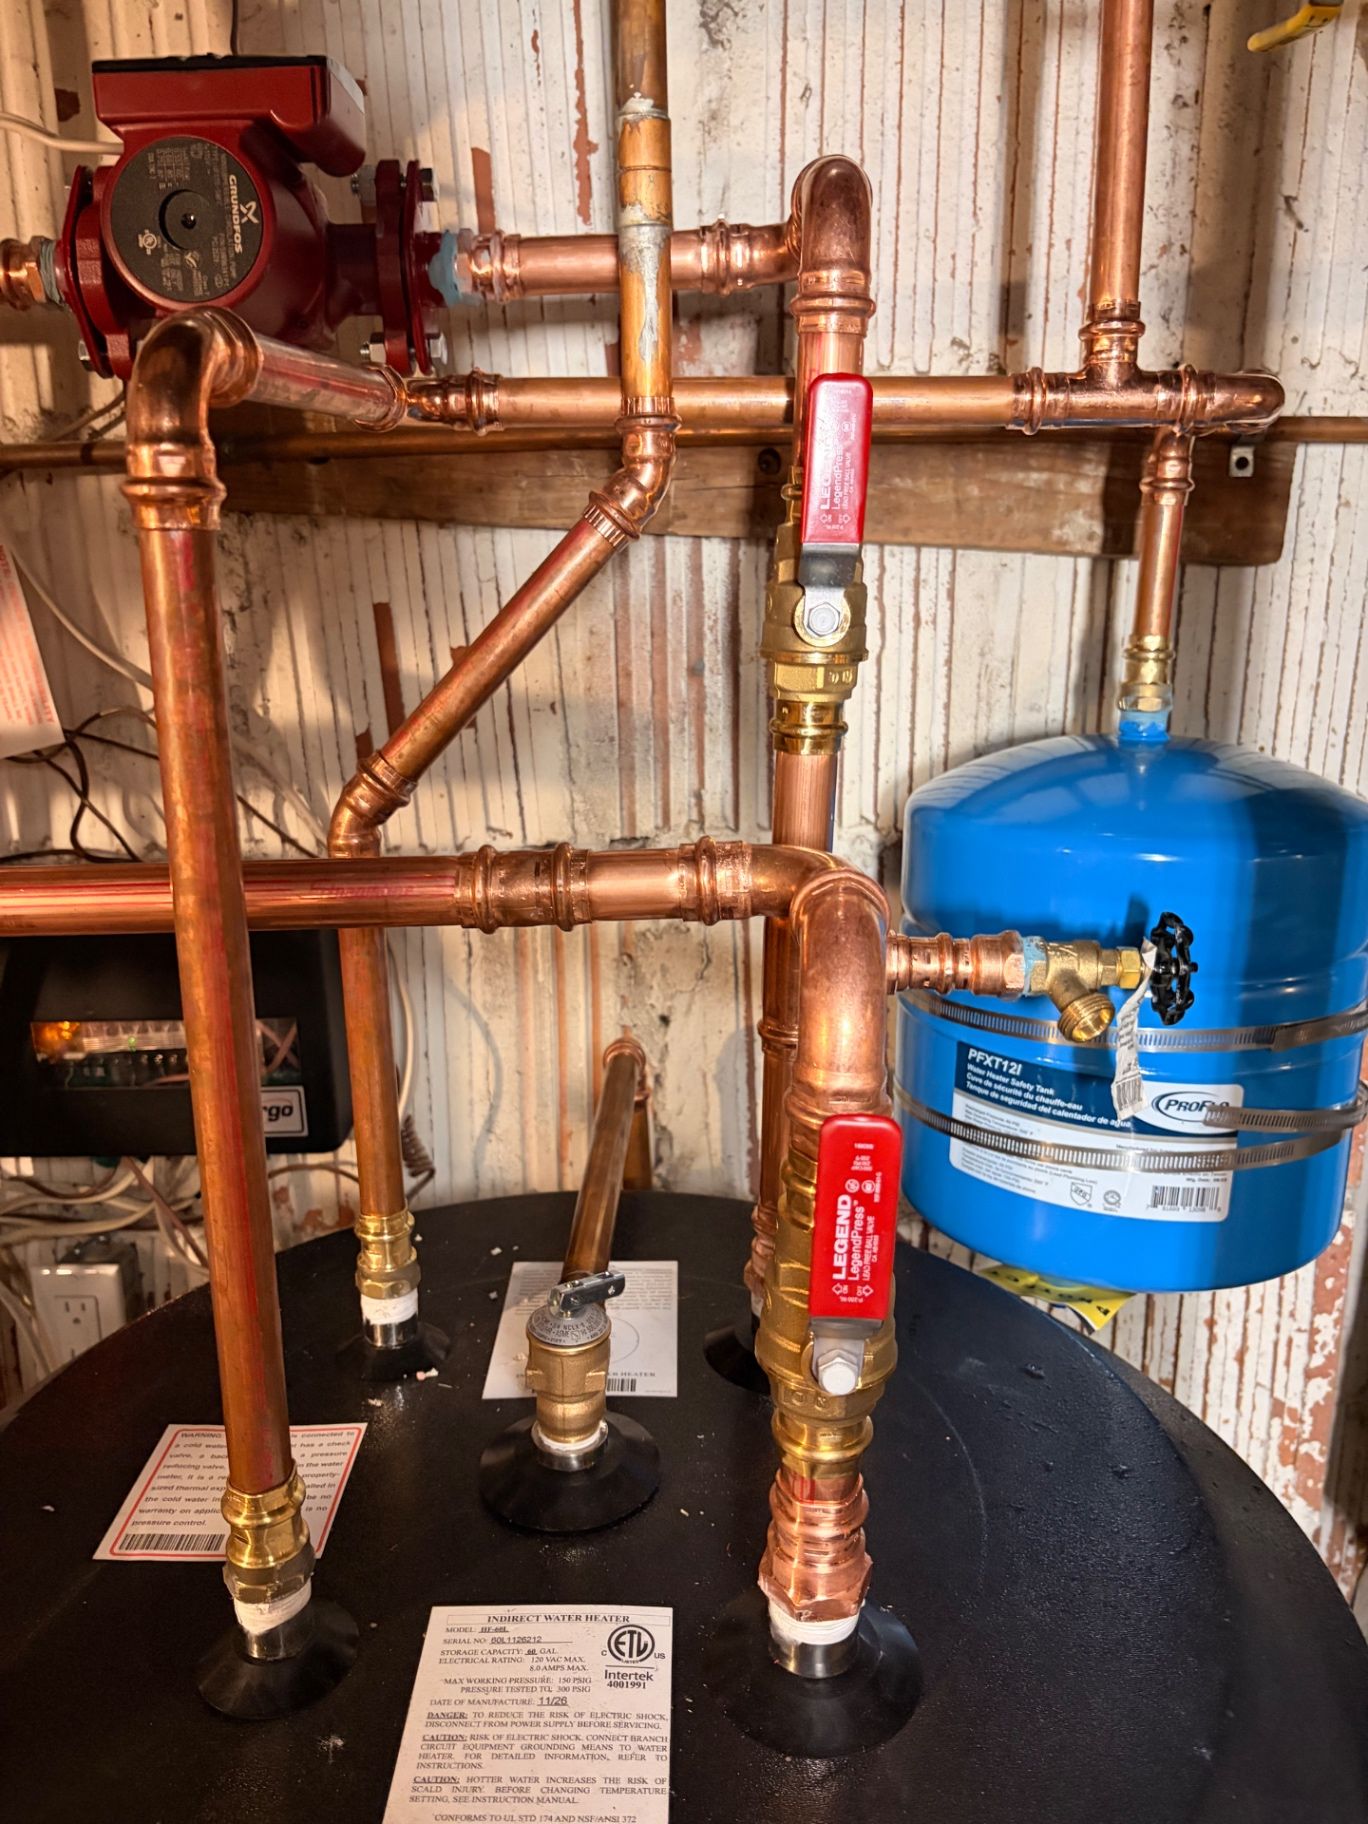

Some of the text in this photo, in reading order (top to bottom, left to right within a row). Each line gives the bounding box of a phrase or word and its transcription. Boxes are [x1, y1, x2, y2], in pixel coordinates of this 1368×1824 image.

[229, 174, 242, 253] GRUNDFOS
[967, 1063, 1055, 1095] Water Heater Safety Tank
[966, 1073, 1083, 1111] Cuve de sécurité du chauffe-eau
[262, 1105, 293, 1122] go
[966, 1081, 1131, 1128] Tanque de seguridad del calentador de agua
[867, 1215, 875, 1233] VALVE
[833, 1195, 851, 1280] LEGEND
[614, 1630, 648, 1658] ETL
[605, 1670, 654, 1681] Intertek
[537, 1697, 568, 1706] 11/26
[506, 1734, 550, 1742] ELECTRIC
[413, 1776, 460, 1784] CAUTION:
